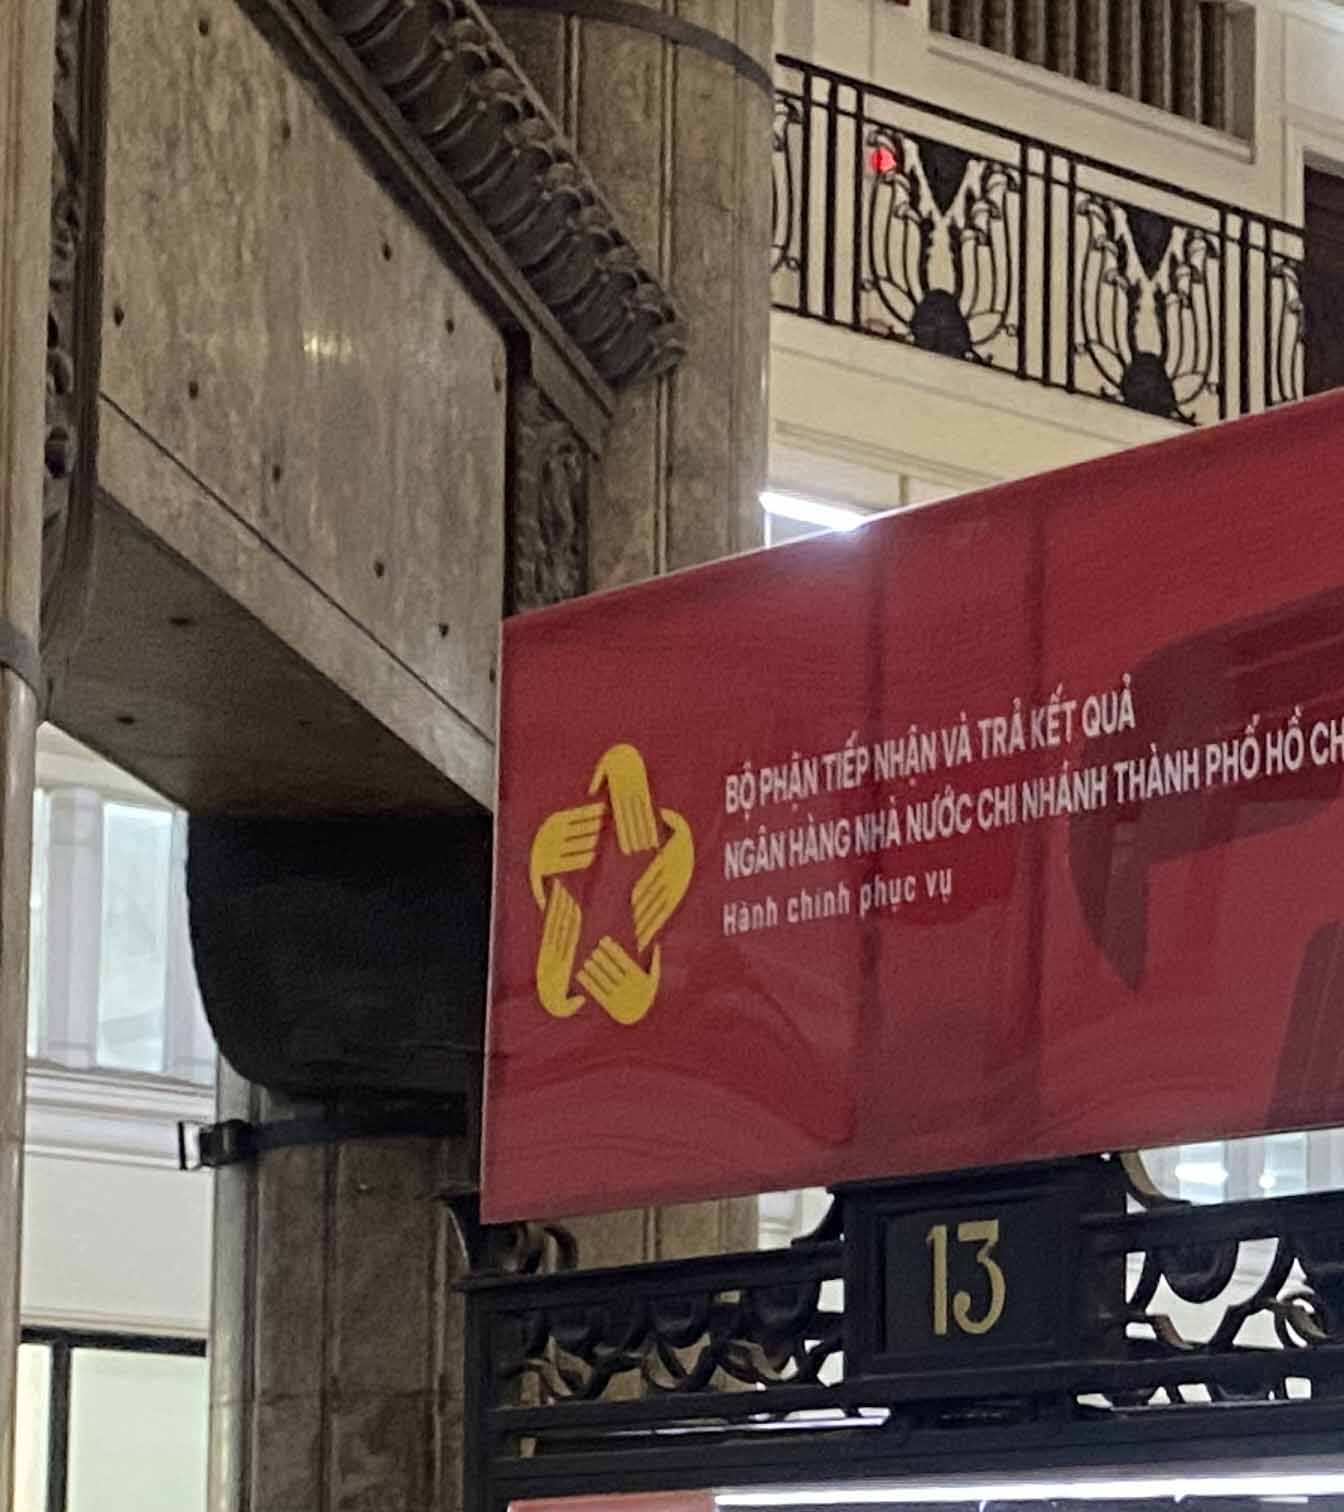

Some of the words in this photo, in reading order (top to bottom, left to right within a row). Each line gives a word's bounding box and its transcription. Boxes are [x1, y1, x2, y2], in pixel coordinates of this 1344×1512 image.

[724, 829, 784, 880] NGÂN
[789, 814, 850, 865] HÀNG
[855, 796, 899, 850] NHÀ
[906, 790, 972, 842] NƯỚC
[977, 782, 1016, 829] CHI
[1023, 761, 1107, 820] NHÁNH
[1113, 742, 1199, 804] THÀNH
[1205, 714, 1261, 786] PHỐ
[1266, 705, 1302, 774] HỒ
[726, 762, 756, 820] BỘ
[760, 752, 819, 811] PHẬN
[823, 730, 868, 794] TIẾP
[874, 724, 936, 786] NHẬN
[941, 712, 971, 767] VÀ
[978, 697, 1025, 756] TRẢ
[1030, 683, 1076, 748] KẾT
[1083, 673, 1135, 737] QUẢ
[724, 895, 777, 936] Hành
[787, 880, 849, 923] chính
[859, 872, 916, 917] phục
[925, 868, 952, 902] vụ
[926, 1219, 1006, 1336] 13
